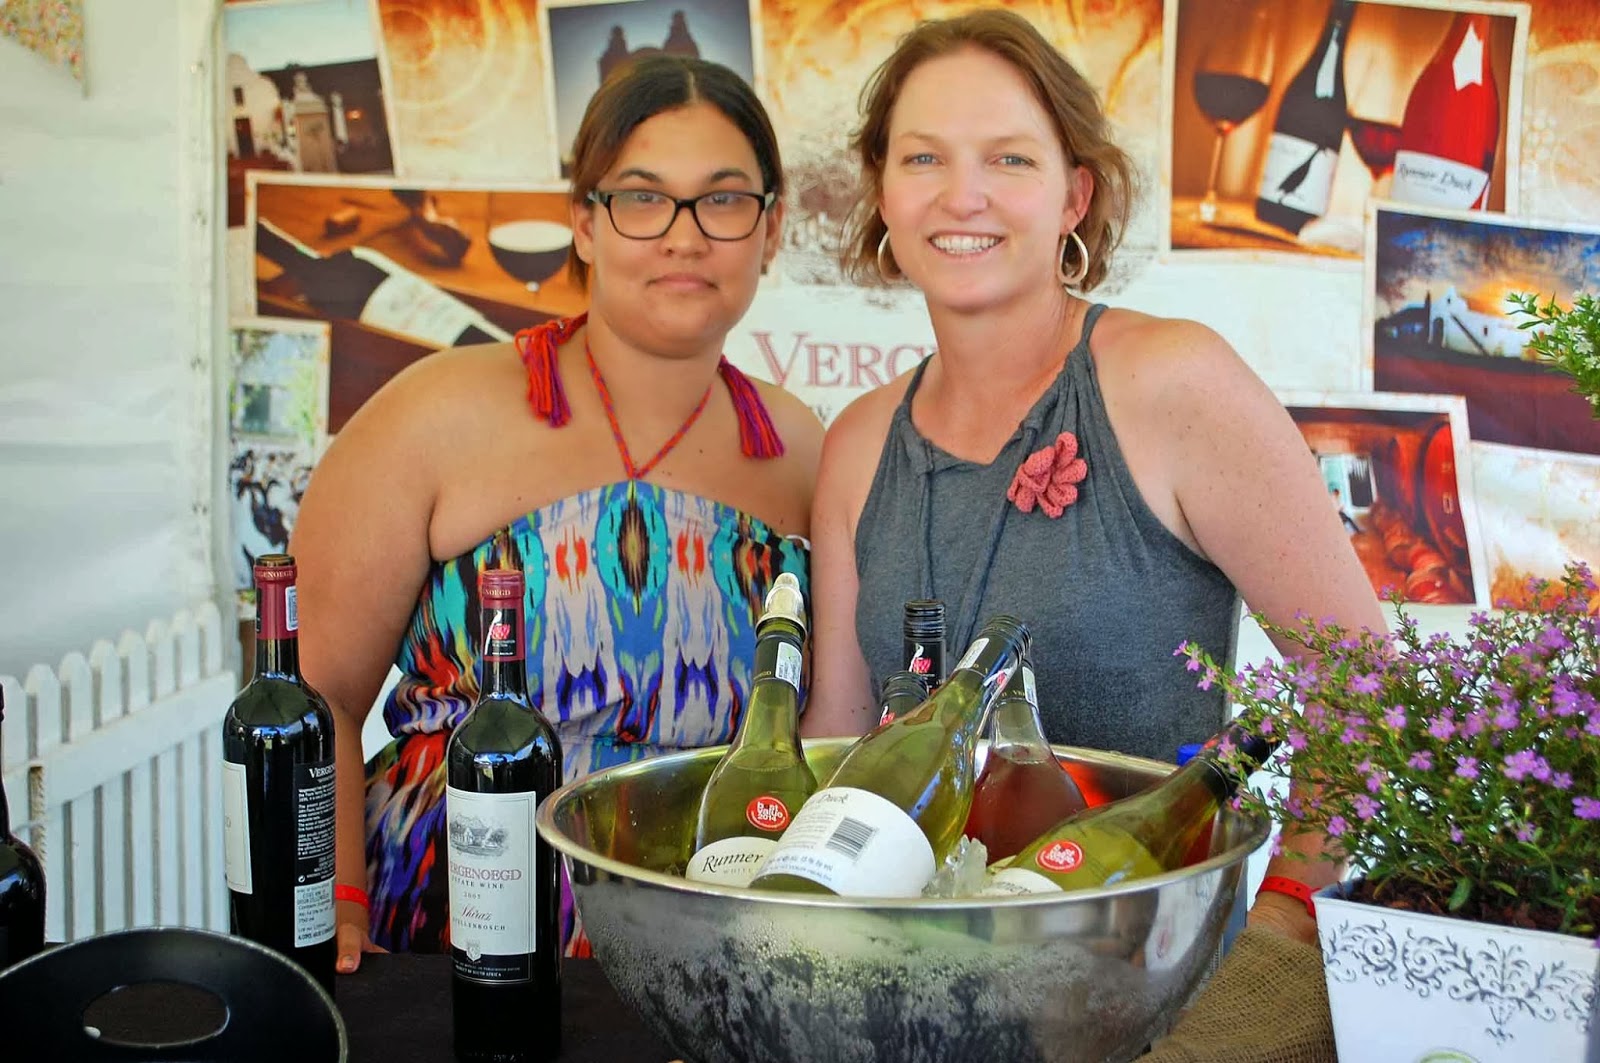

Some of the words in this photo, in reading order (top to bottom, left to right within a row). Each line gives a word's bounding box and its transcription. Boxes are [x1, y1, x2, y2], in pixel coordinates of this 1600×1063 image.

[702, 853, 763, 874] Runner
[480, 882, 504, 890] WINE
[462, 903, 492, 921] Shiraz
